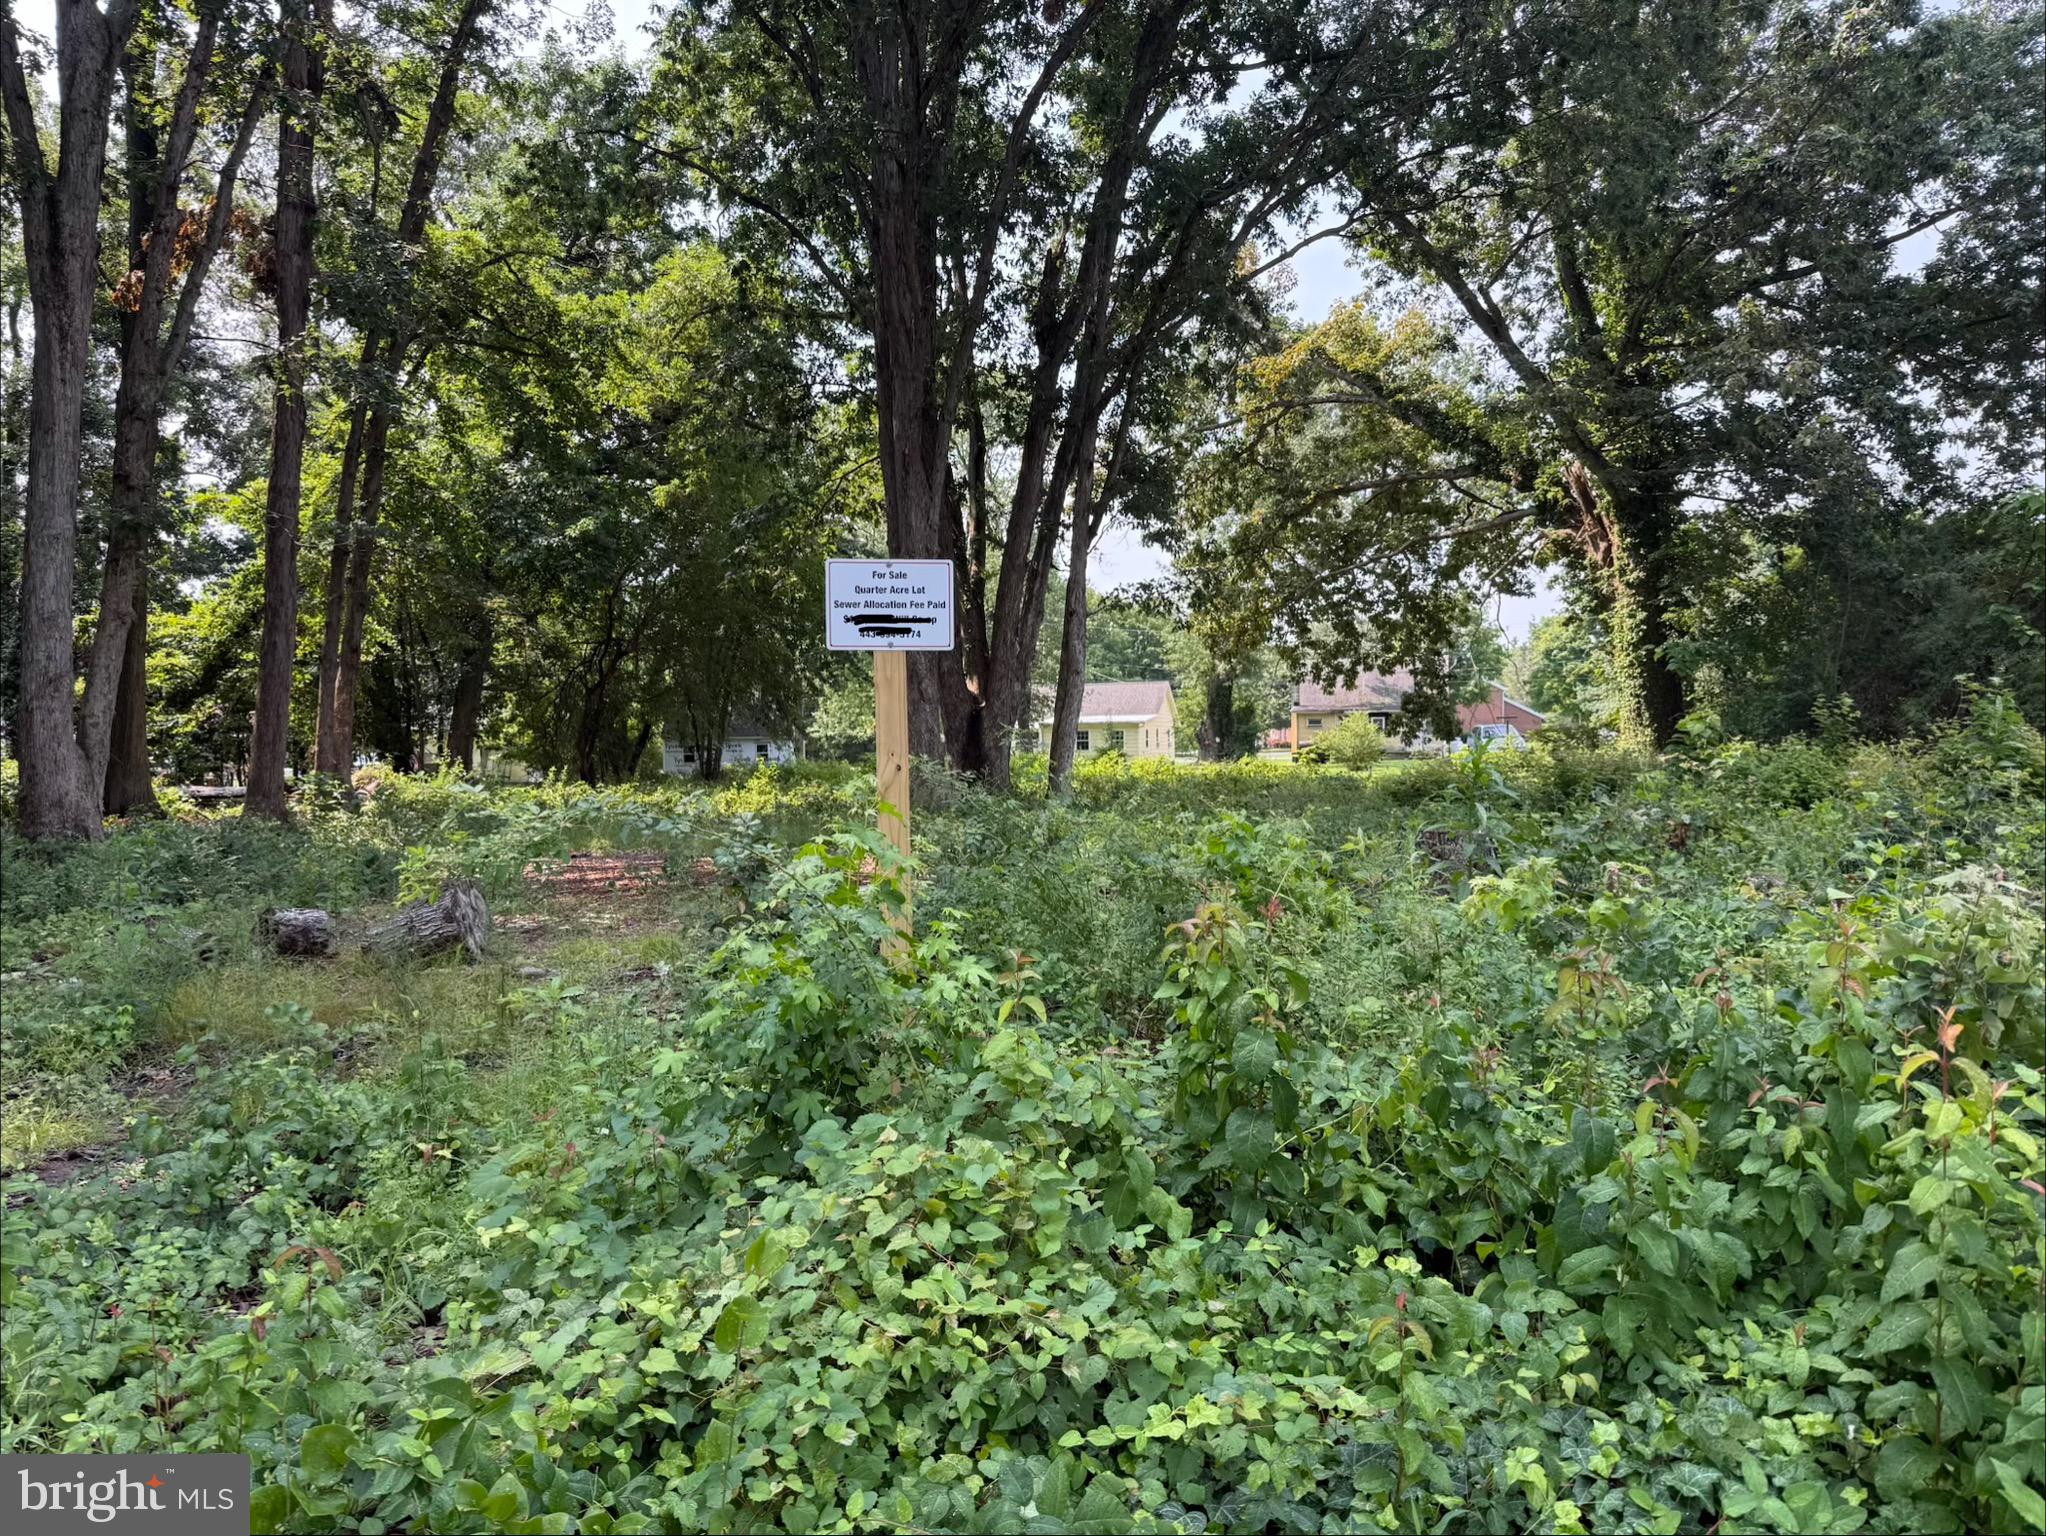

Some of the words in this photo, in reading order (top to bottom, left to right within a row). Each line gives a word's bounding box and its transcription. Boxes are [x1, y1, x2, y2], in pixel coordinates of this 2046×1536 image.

[872, 571, 886, 579] For
[889, 571, 907, 579] Sale
[854, 586, 887, 594] Quarter
[890, 586, 909, 594] Acre
[912, 586, 925, 594] Lot
[833, 600, 861, 609] Sewer
[863, 600, 907, 609] Allocation
[910, 600, 925, 609] Fee
[927, 600, 946, 609] Paid
